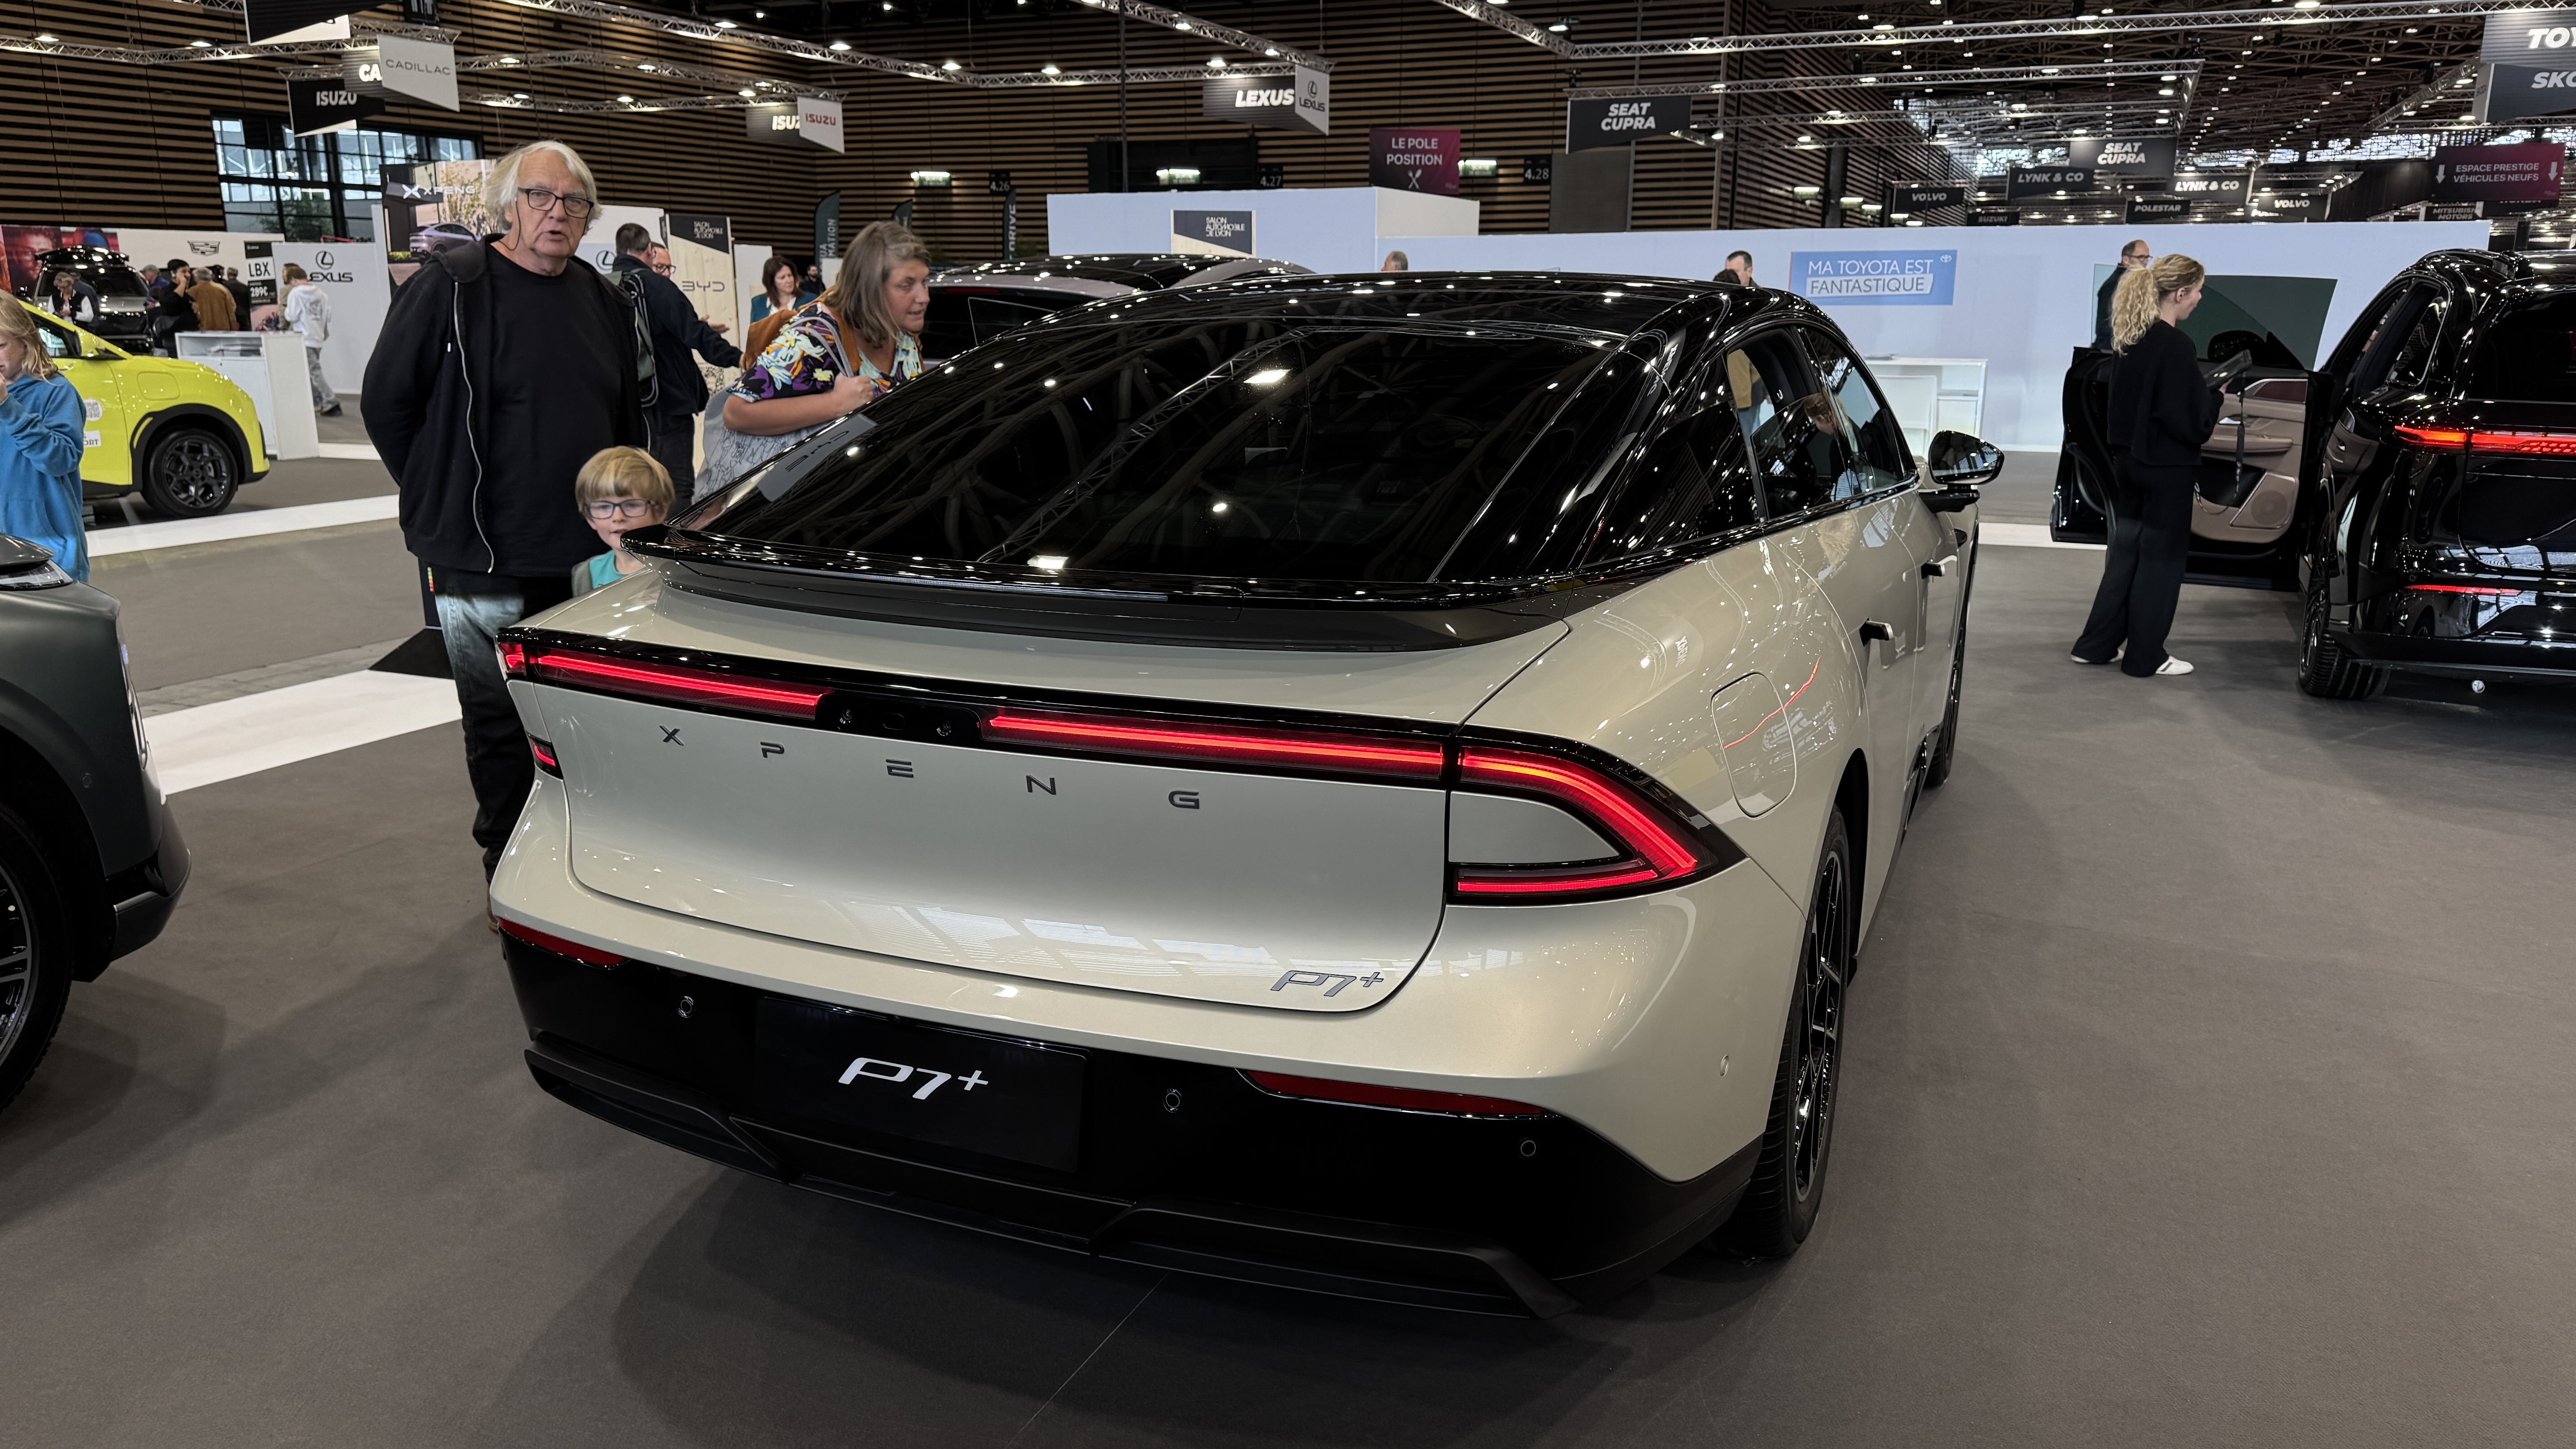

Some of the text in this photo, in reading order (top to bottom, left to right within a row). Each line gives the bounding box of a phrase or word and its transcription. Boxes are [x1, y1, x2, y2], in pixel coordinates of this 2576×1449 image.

[2528, 27, 2576, 49] TO
[386, 59, 451, 75] CADILLAC
[316, 91, 357, 106] ISUZU
[1235, 89, 1295, 107] LEXUS
[1299, 97, 1325, 112] LEXUS
[1608, 102, 1651, 116] SEAT
[805, 113, 836, 126] ISUZU
[1601, 116, 1656, 131] CUPRA
[1392, 137, 1438, 149] LE POLE
[2104, 142, 2142, 153] SEAT
[1386, 154, 1443, 165] POSITION
[2097, 152, 2146, 165] CUPRA
[1525, 168, 1549, 179] 4.28
[2456, 163, 2539, 172] ESPACE PRESTIGE
[2018, 172, 2084, 183] LYNK & CO
[2454, 173, 2539, 183] VÉHICULES NEUFS
[424, 185, 476, 195] XPENG
[2175, 181, 2208, 192] LYNK
[2221, 180, 2240, 190] CO
[1912, 193, 1947, 201] VOLVO
[2134, 204, 2181, 212] POLESTAR
[2275, 200, 2310, 208] VOLVO
[248, 262, 271, 276] LBX
[1808, 259, 1933, 275] MA TOYOTA EST
[308, 272, 354, 282] EXUS
[682, 281, 725, 292] BYD
[1811, 277, 1925, 294] FANTASTIQUE
[1270, 970, 1385, 997] P7+
[838, 1057, 989, 1100] P7+
